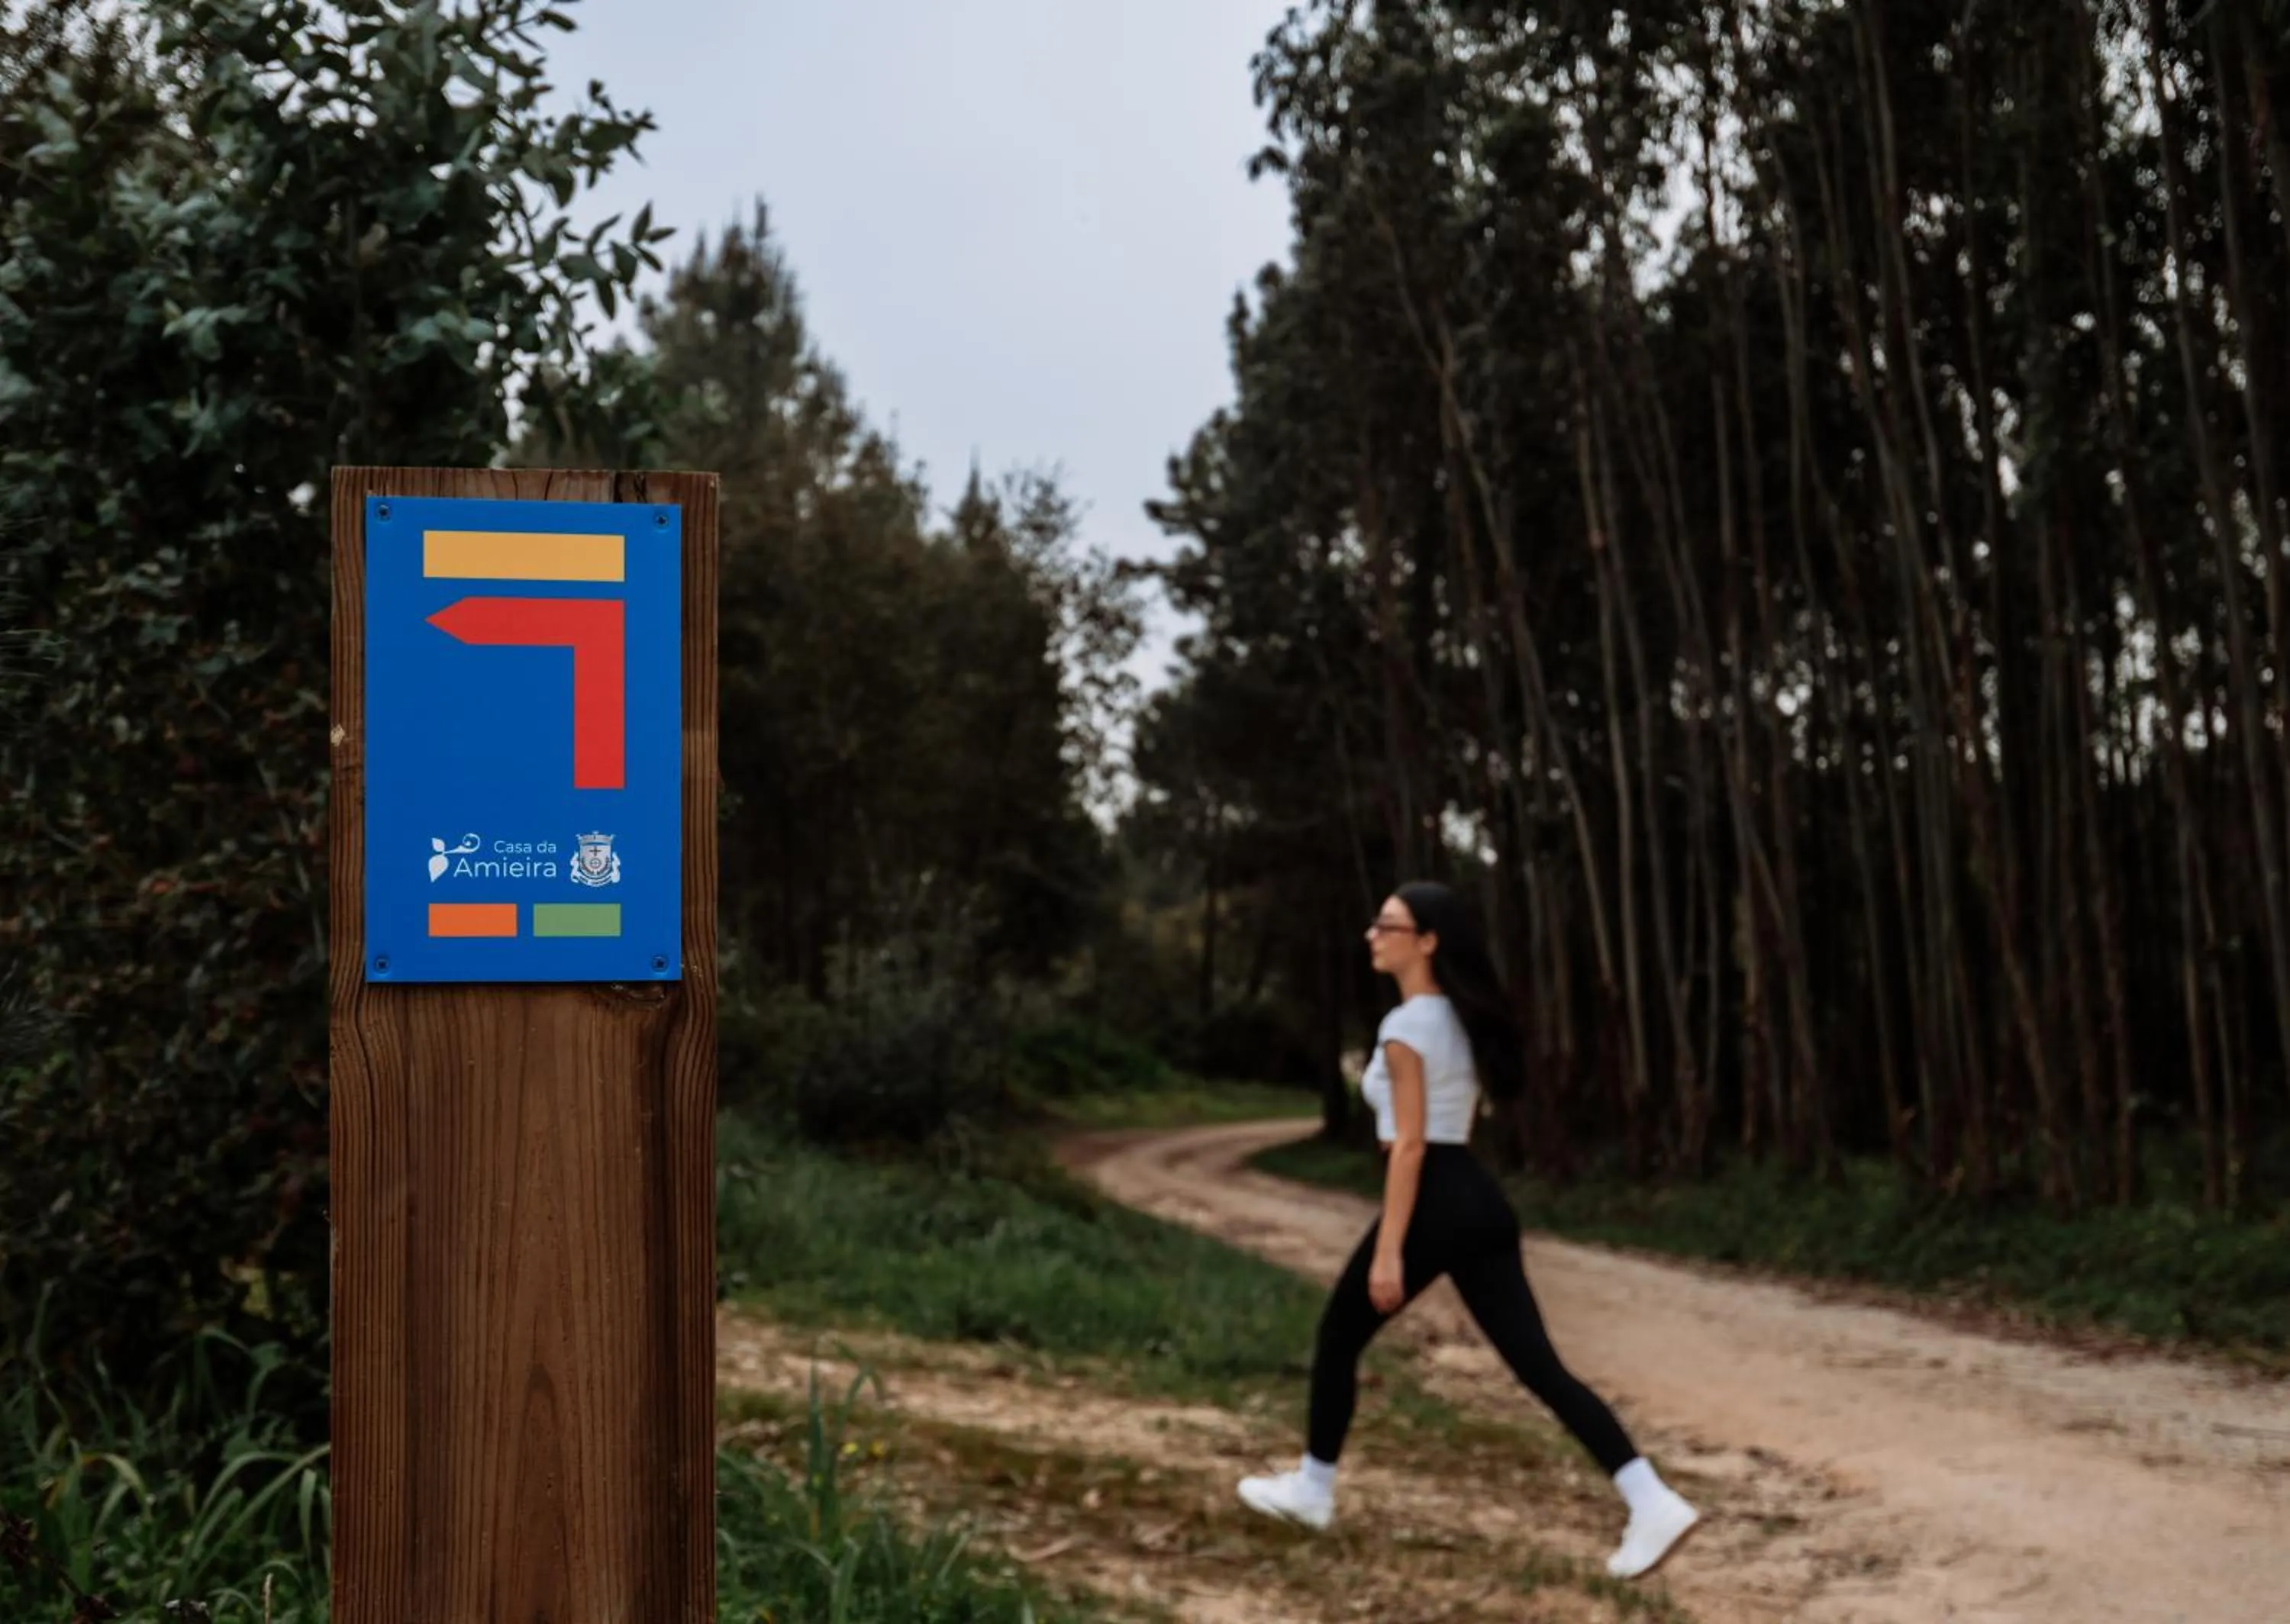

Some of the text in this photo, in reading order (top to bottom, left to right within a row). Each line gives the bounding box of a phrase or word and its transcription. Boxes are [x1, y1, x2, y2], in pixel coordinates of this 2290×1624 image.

[494, 840, 556, 854] Casa da
[453, 857, 556, 878] Amieira
